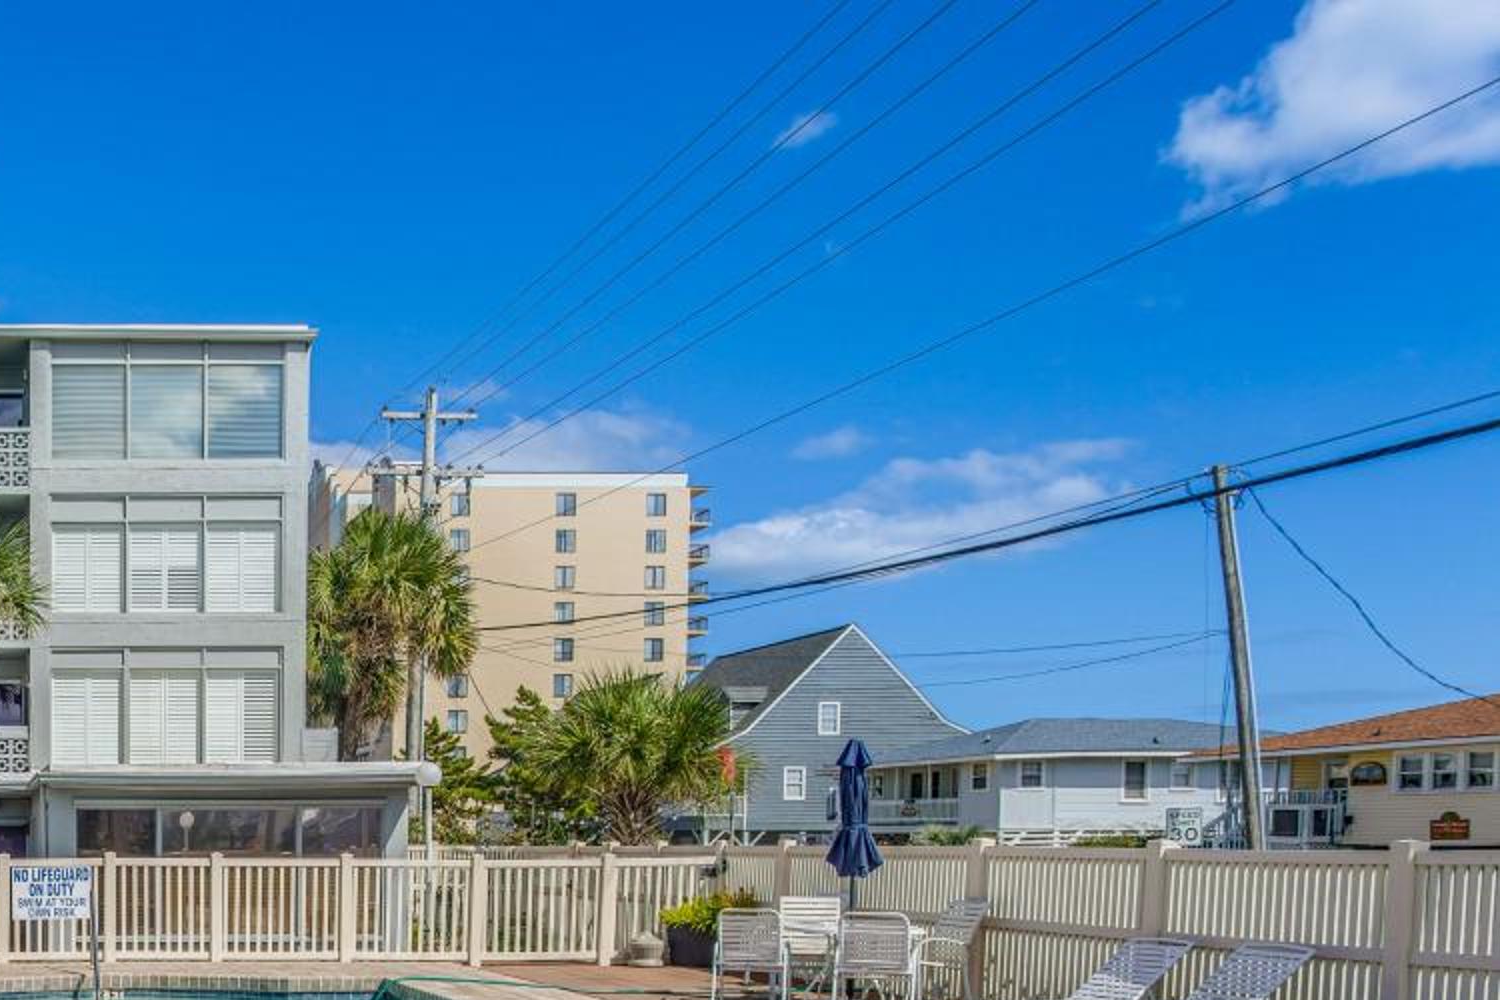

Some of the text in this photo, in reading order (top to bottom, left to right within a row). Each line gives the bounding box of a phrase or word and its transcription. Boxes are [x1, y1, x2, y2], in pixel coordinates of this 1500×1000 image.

[1170, 811, 1200, 819] SPEED
[1170, 827, 1198, 841] 30
[13, 867, 89, 882] NO LIFEGUARD
[29, 883, 74, 897] ON DUTY
[45, 897, 57, 907] AT
